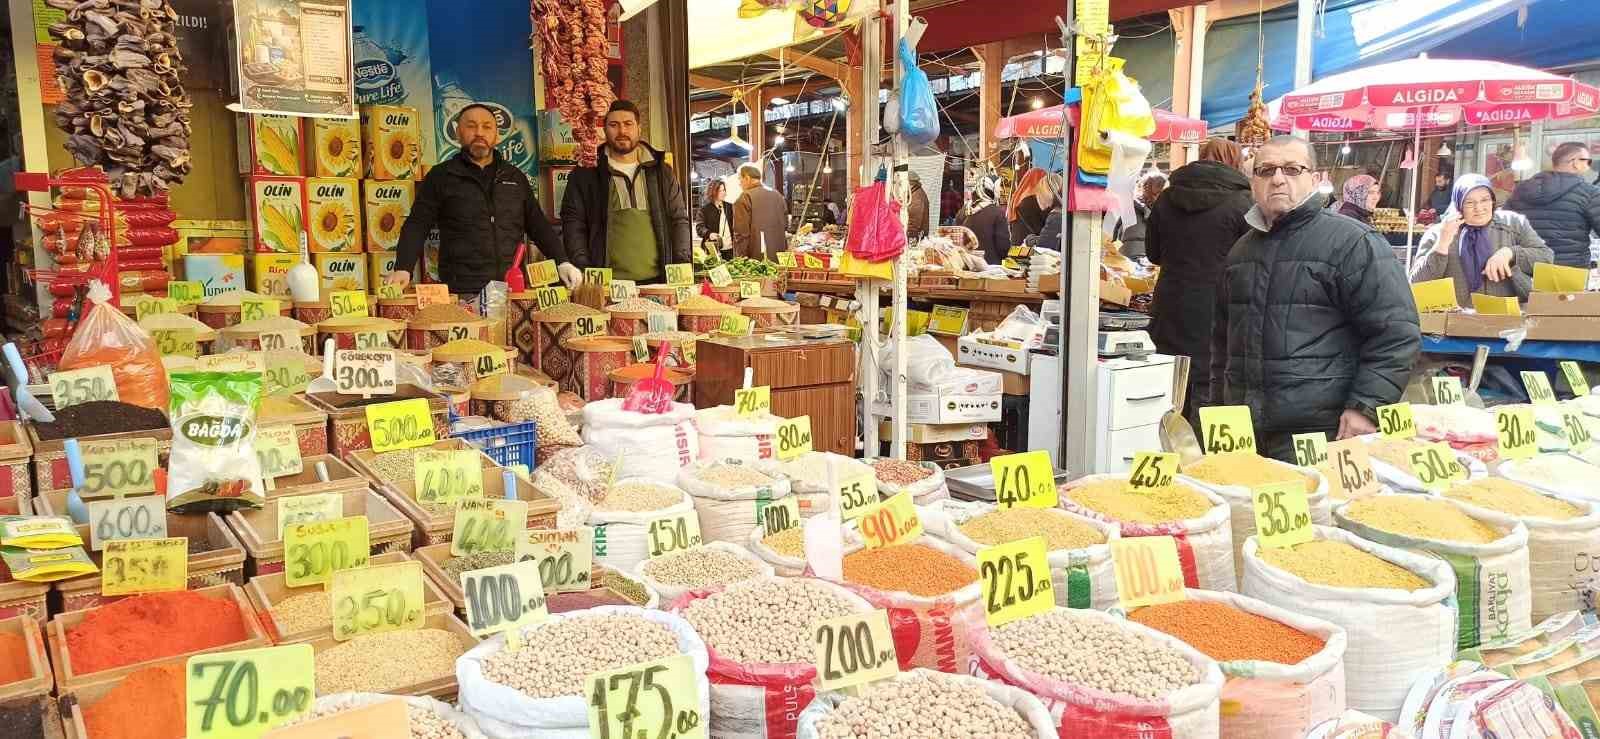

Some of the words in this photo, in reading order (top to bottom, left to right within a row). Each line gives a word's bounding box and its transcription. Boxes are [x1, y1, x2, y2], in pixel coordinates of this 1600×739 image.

[778, 423, 810, 451] 80.00
[1207, 424, 1253, 454] 45.00
[1498, 413, 1535, 449] 30.00
[998, 464, 1053, 508] 40.00
[1129, 455, 1172, 489] 45.00
[841, 482, 877, 510] 55.00
[1258, 491, 1309, 536] 35.00
[648, 516, 702, 557] 150.00
[862, 507, 918, 550] 90.00
[519, 552, 589, 588] 00.00
[981, 552, 1050, 614] 225.00
[465, 573, 546, 630] 100.00
[816, 621, 895, 680] 200.00
[191, 660, 310, 732] 70.00
